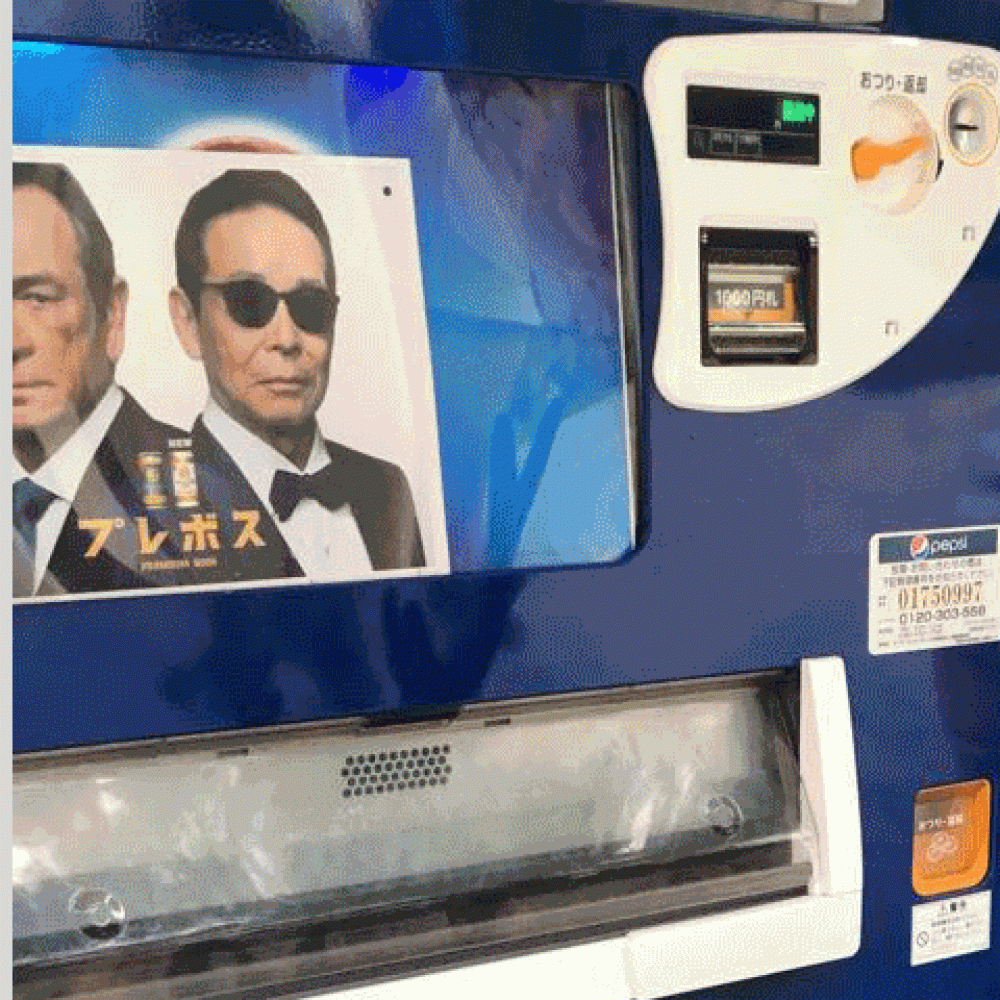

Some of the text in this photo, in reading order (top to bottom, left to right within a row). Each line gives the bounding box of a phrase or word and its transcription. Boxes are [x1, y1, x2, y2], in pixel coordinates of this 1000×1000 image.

[78, 508, 267, 558] プレボス
[931, 535, 968, 555] pepsi
[898, 581, 982, 610] 01750997
